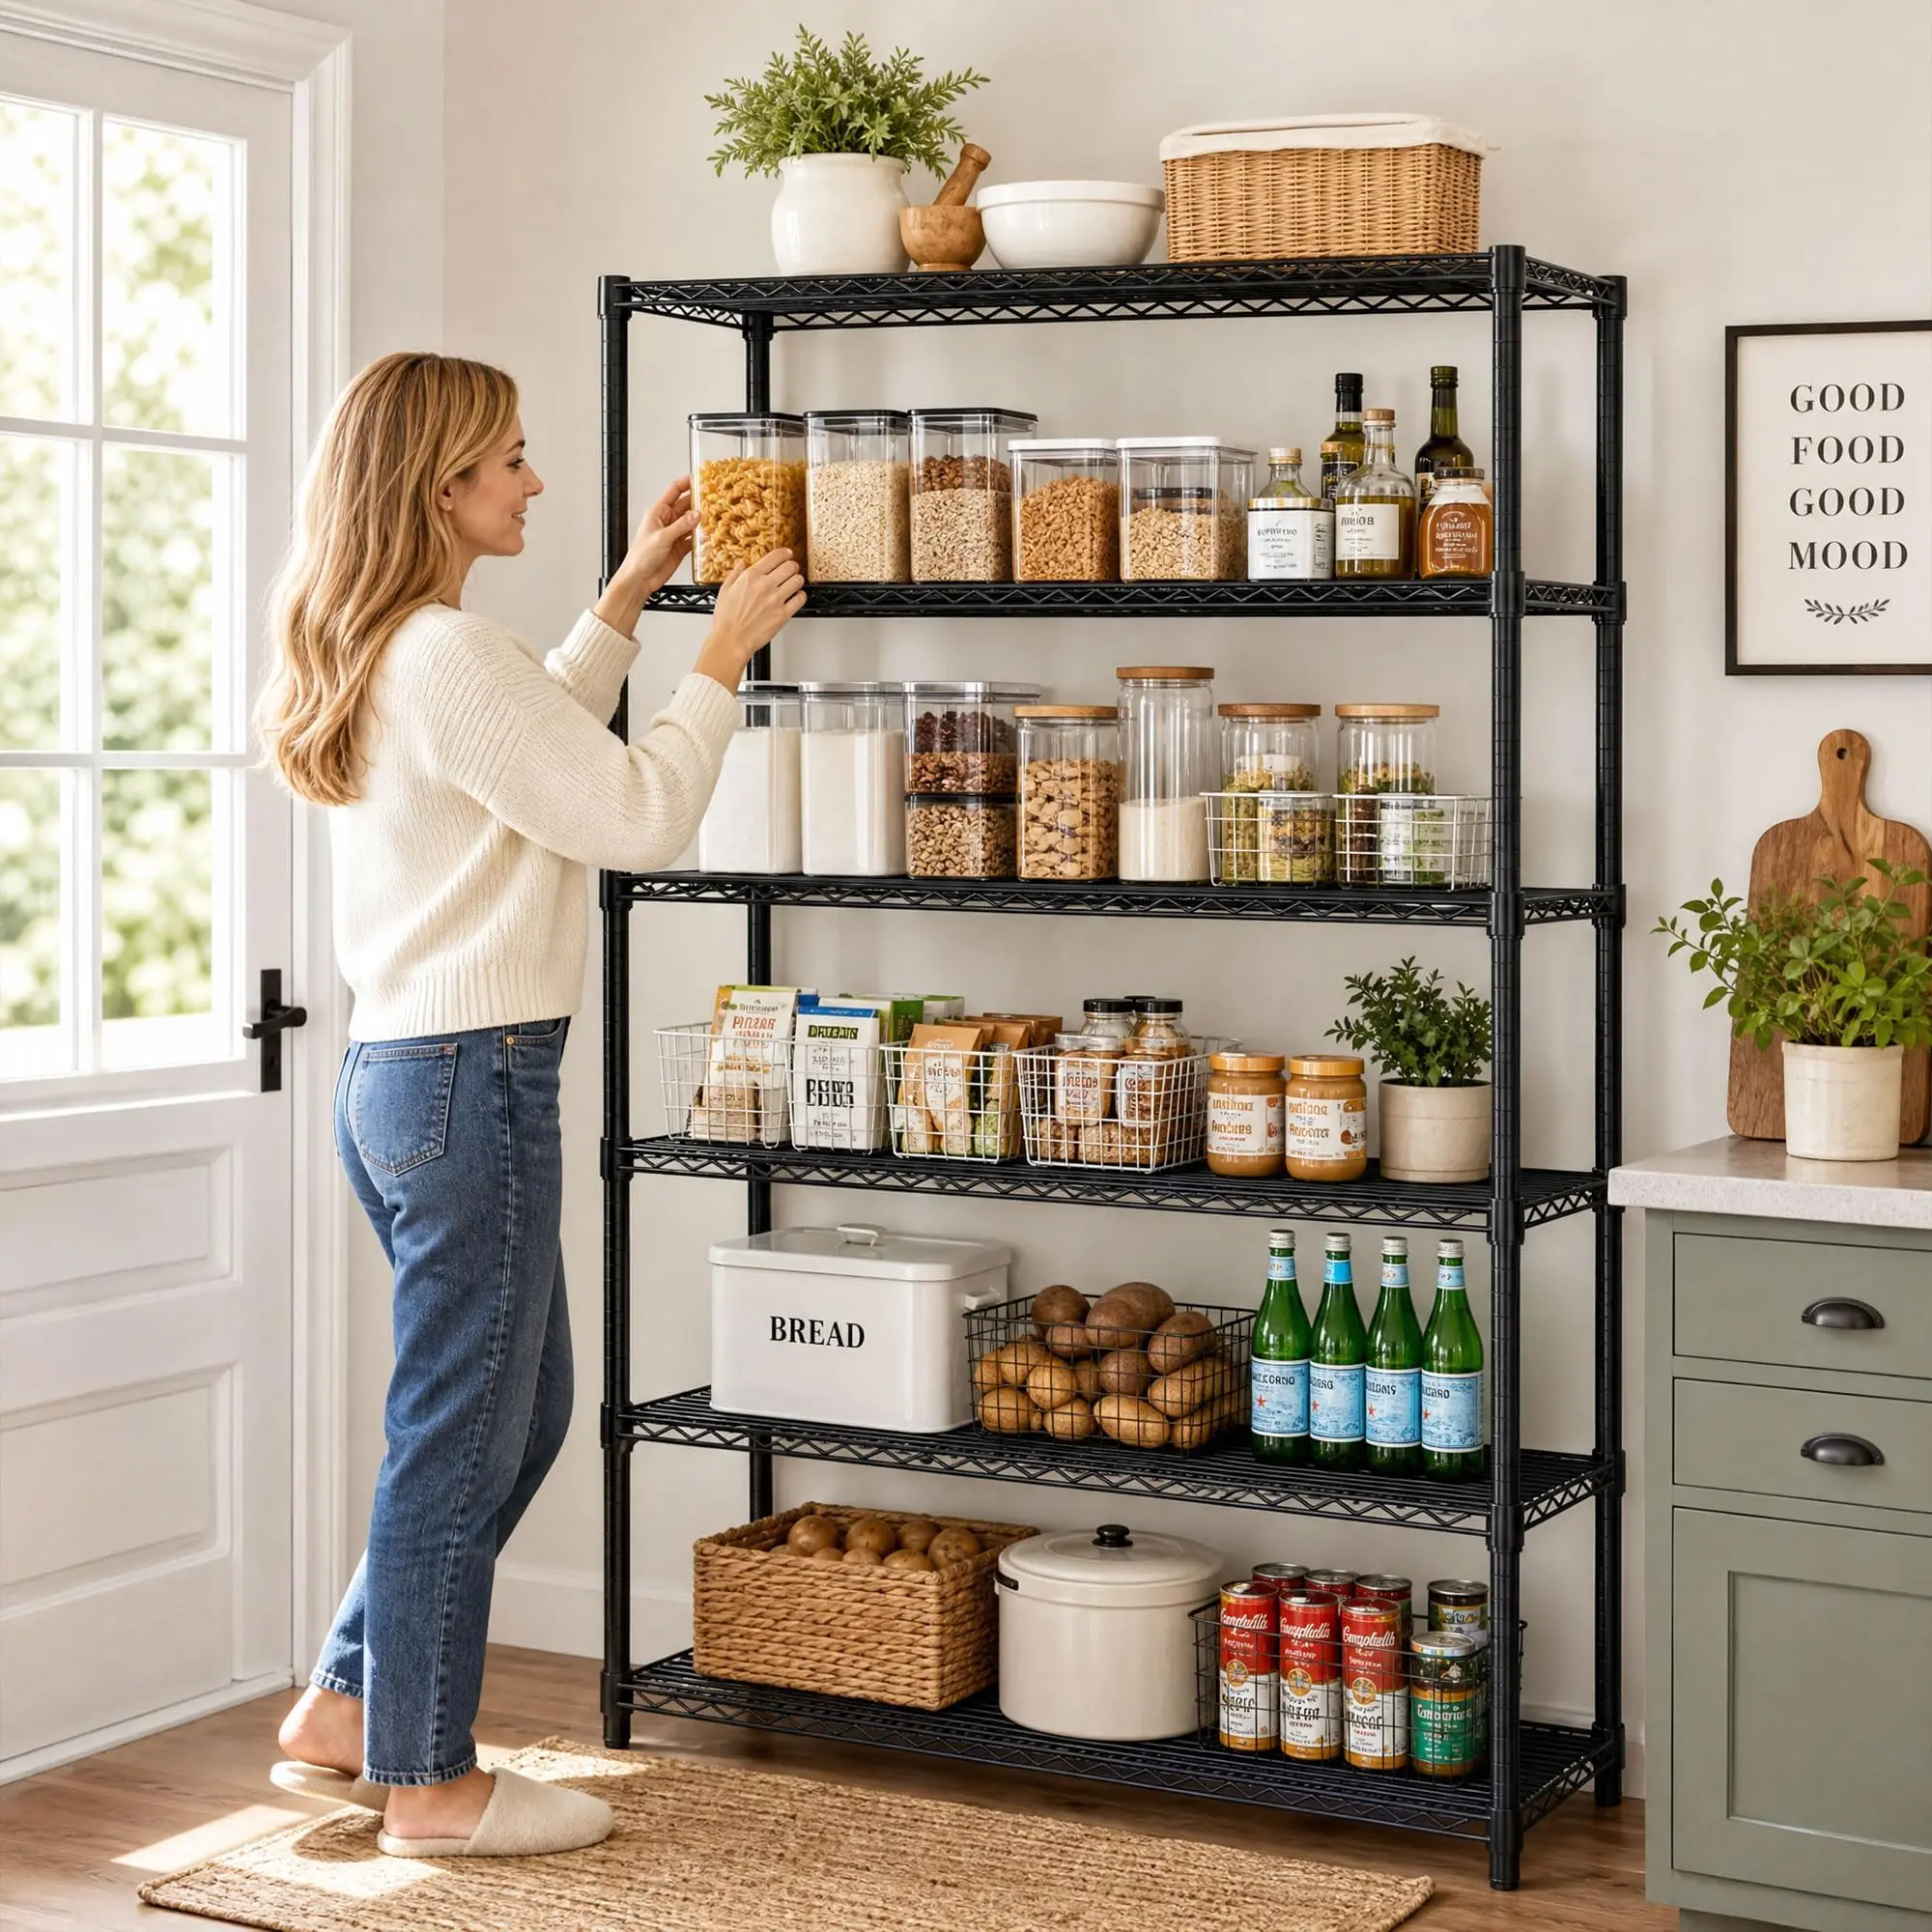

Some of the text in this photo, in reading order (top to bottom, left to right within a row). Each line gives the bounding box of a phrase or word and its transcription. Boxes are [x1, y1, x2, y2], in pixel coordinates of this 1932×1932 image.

[1791, 384, 1904, 412] GOOD
[1792, 436, 1904, 465] FOOD
[1790, 488, 1904, 516] GOOD
[1789, 541, 1907, 569] MOOD
[770, 1316, 865, 1348] BREAD
